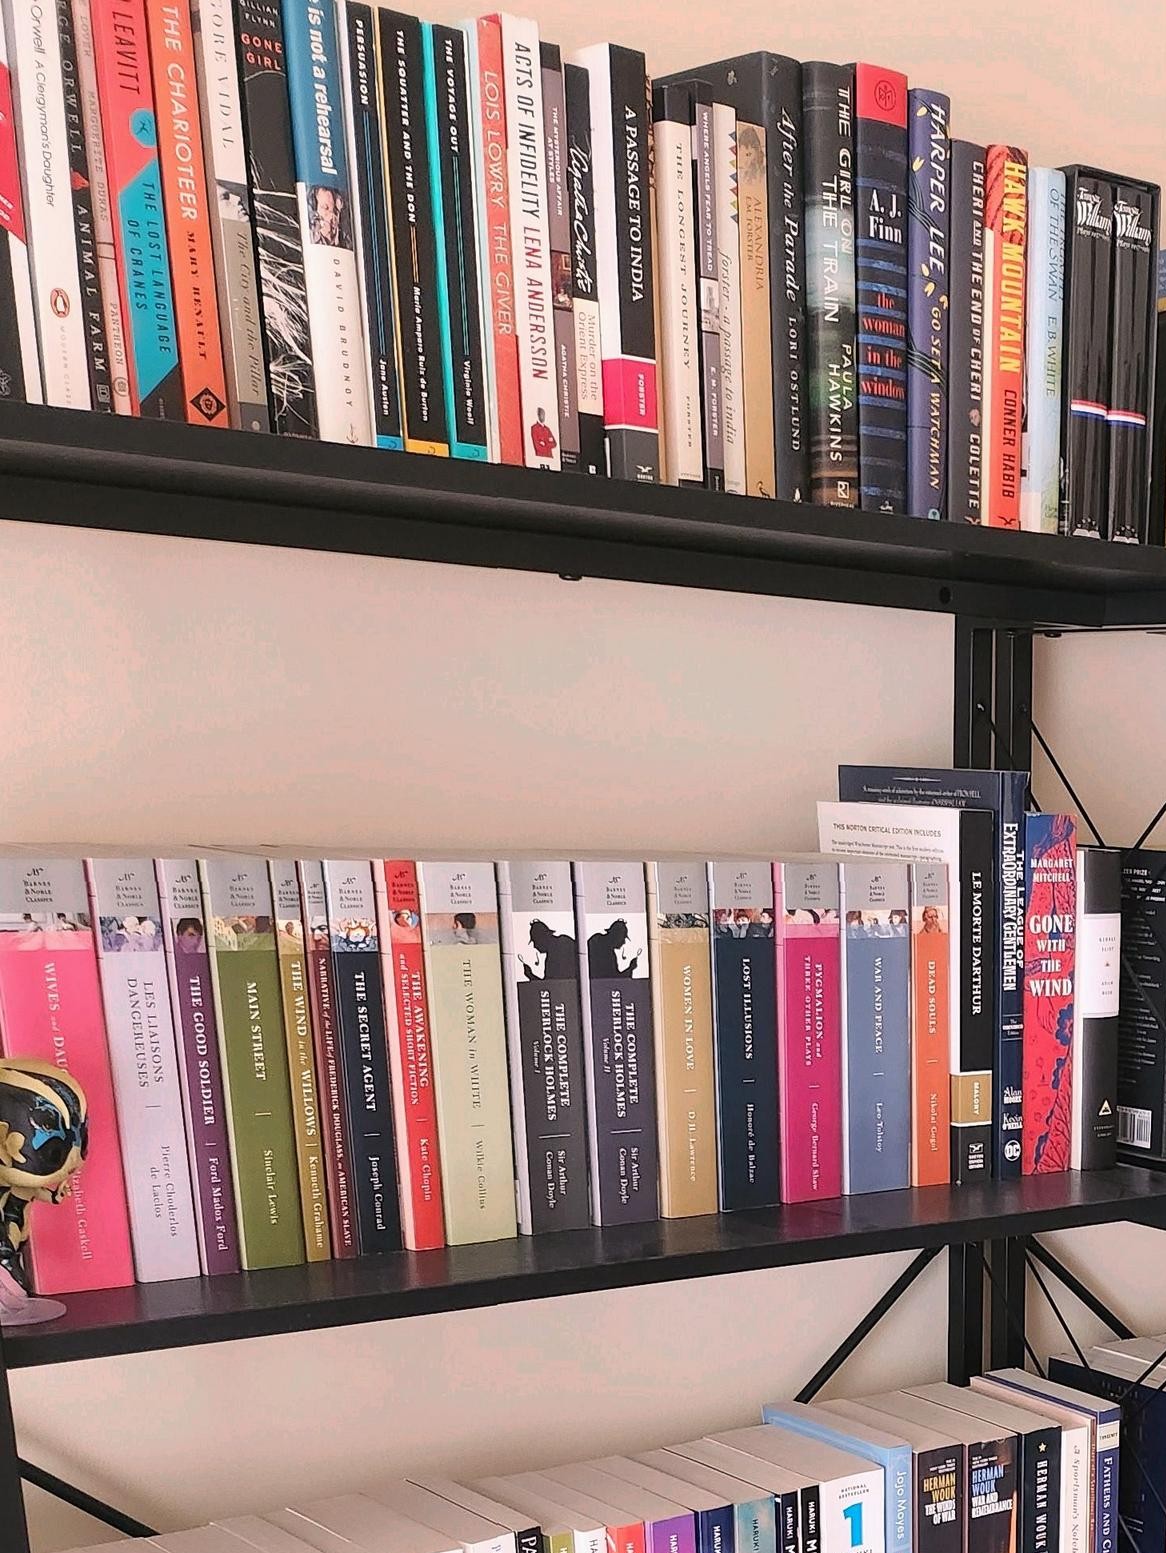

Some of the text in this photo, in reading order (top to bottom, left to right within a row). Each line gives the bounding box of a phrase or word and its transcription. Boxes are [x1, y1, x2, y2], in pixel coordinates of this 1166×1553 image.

[112, 11, 140, 95] LEAVITT
[240, 34, 282, 54] GONE
[246, 52, 282, 70] GIRL
[307, 7, 337, 176] is not a rehearsal
[160, 6, 198, 220] THE CHARIOTEER
[481, 70, 504, 208] LOIS LOWRY
[514, 42, 548, 380] ACTS OF INFIDELITY LENA ANDERSSON
[625, 124, 641, 209] PASSAGE
[838, 86, 852, 254] THE GIRL ON
[928, 104, 947, 275] HARPER LEE
[629, 215, 642, 243] TO
[631, 247, 644, 302] INDIA
[822, 175, 840, 323] THE TRAIN
[869, 216, 902, 244] Finn
[999, 161, 1027, 373] HAWK MOUNTAIN
[75, 205, 106, 371] ANIMAL FARM
[493, 223, 512, 336] THE GIVER
[828, 363, 843, 462] HAWKINS
[841, 343, 852, 411] PAULA
[1000, 389, 1019, 499] CONNER HABIB
[1031, 858, 1073, 869] MARGARET
[1033, 871, 1071, 882] MITCHELL
[971, 872, 981, 1016] LE MORTE DARTHUR
[1029, 915, 1073, 933] GONE
[1037, 940, 1066, 952] WITH
[1041, 960, 1061, 972] THE
[247, 982, 266, 1081] MAIN STREET
[1029, 979, 1072, 997] WIND
[354, 971, 376, 1111] THE SECRET AGENT
[539, 990, 557, 1121] SHERLOCK HOLMES
[555, 1003, 570, 1108] THE COMPLETE
[843, 1502, 863, 1548] 1
[1035, 1460, 1048, 1549] HERMAN WOUK
